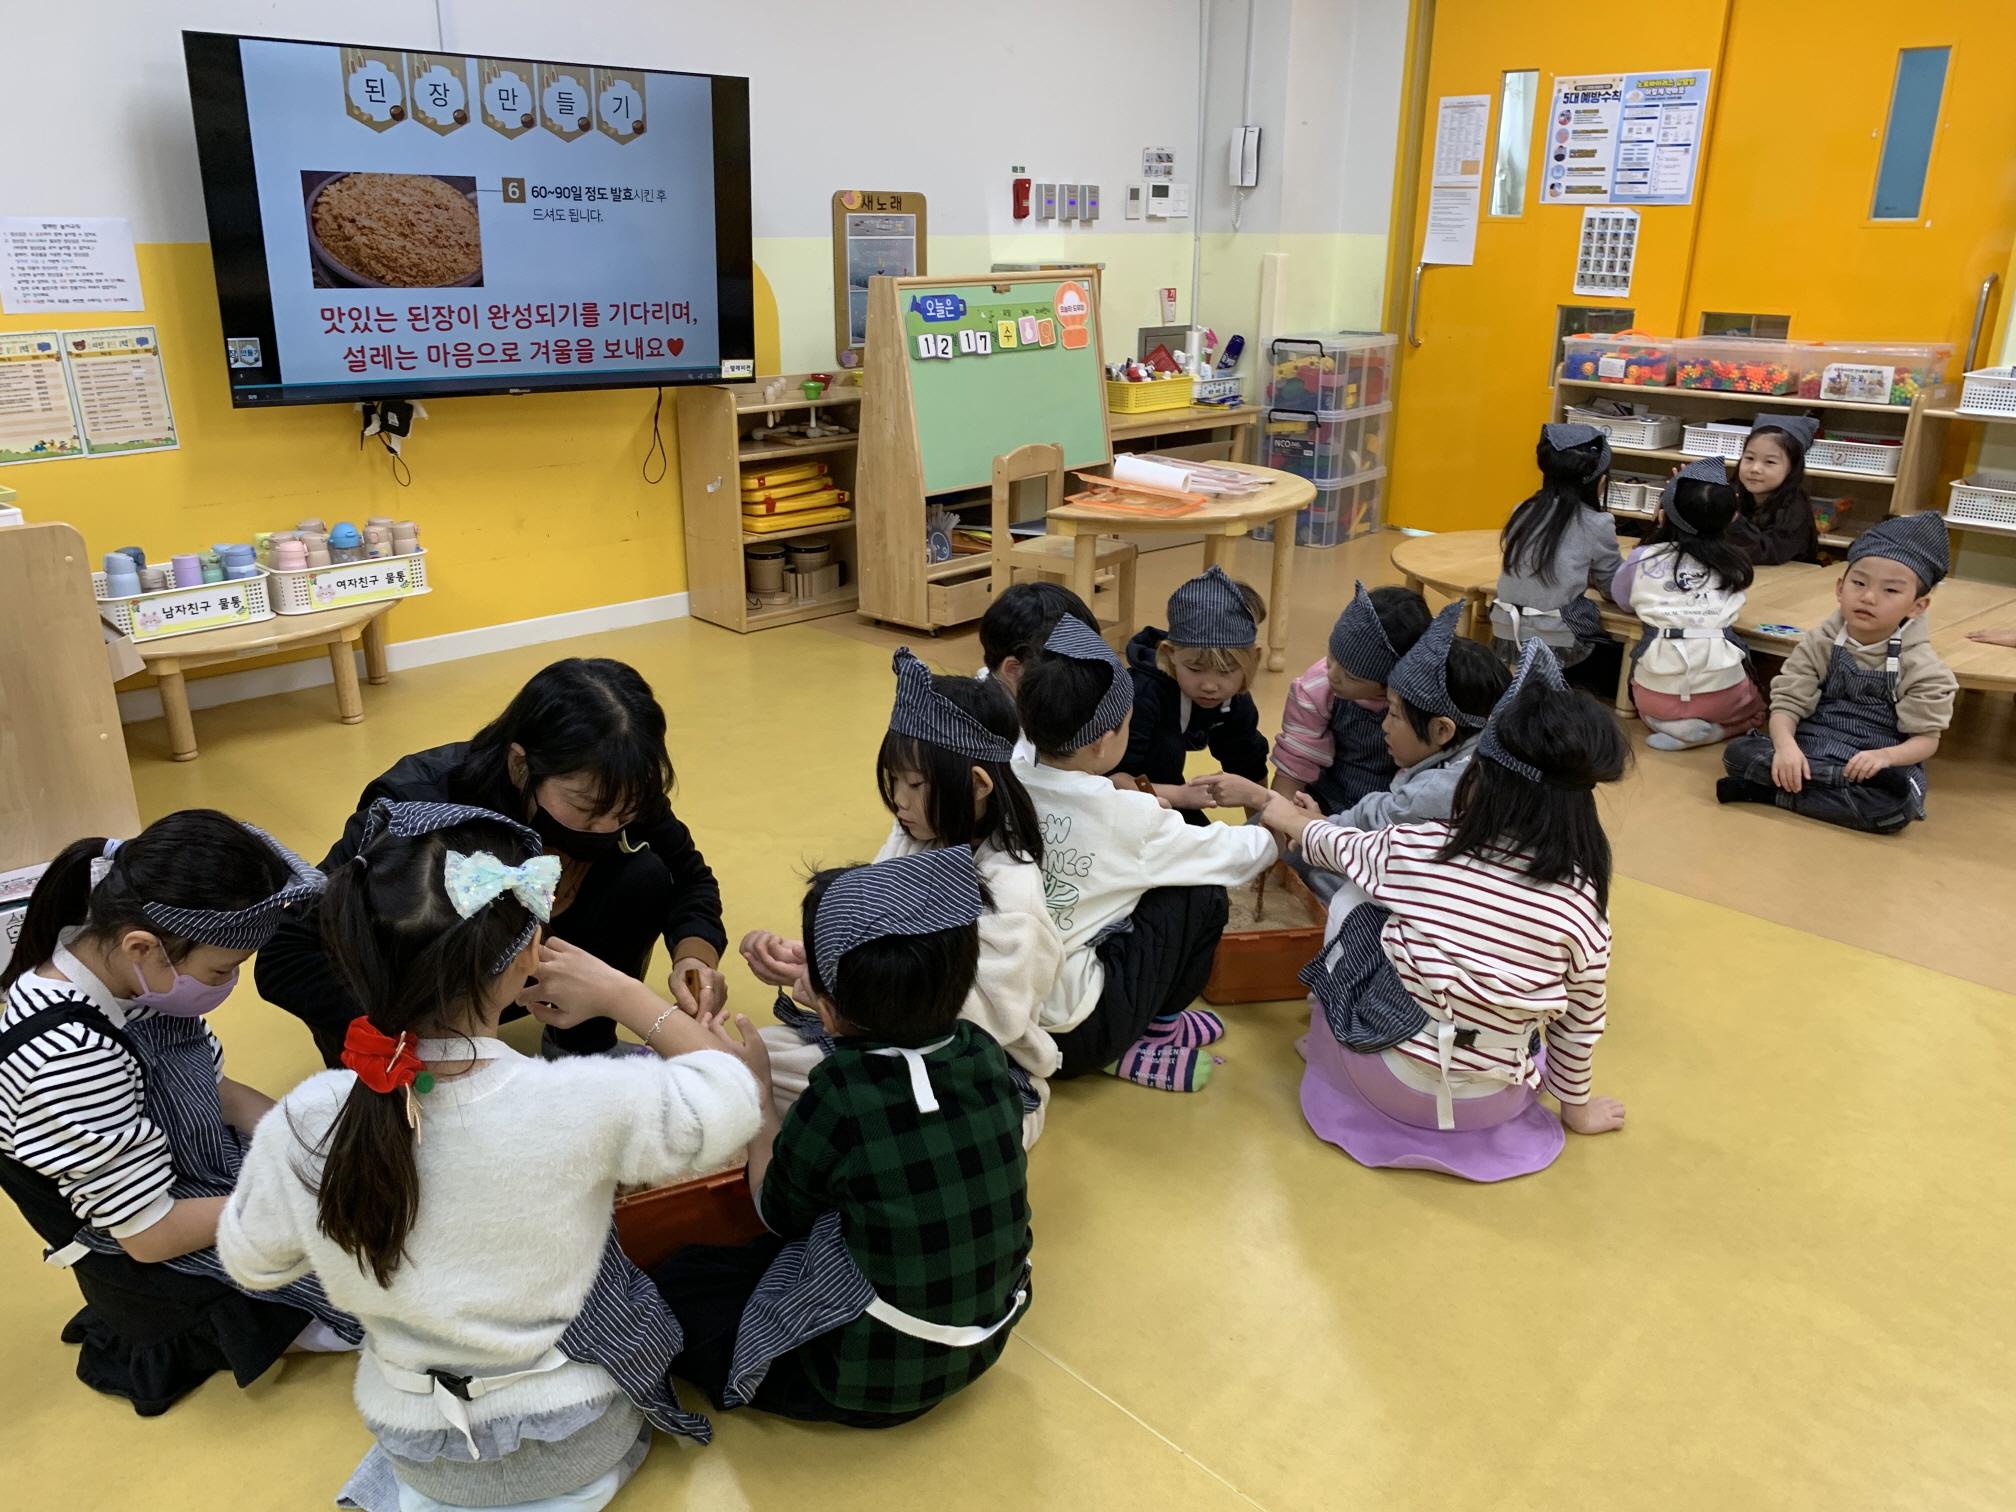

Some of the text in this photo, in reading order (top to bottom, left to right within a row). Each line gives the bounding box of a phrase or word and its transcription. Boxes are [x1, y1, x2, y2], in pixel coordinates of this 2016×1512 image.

[1563, 90, 1622, 104] 5대 예방수칙
[508, 182, 520, 199] 6
[531, 185, 667, 203] 60~90일 정도 발효시킨 후
[532, 208, 604, 223] 드셔도 됩니다.
[926, 298, 955, 318] 오늘은
[320, 300, 698, 335] 맛있는 된장이 완성되기를 기다리며,
[1003, 326, 1013, 342] 수
[342, 336, 667, 373] 설레는 마음으로 겨울을 보내요
[336, 571, 406, 590] 여자친구 물통
[162, 596, 241, 619] 남자친구 물통
